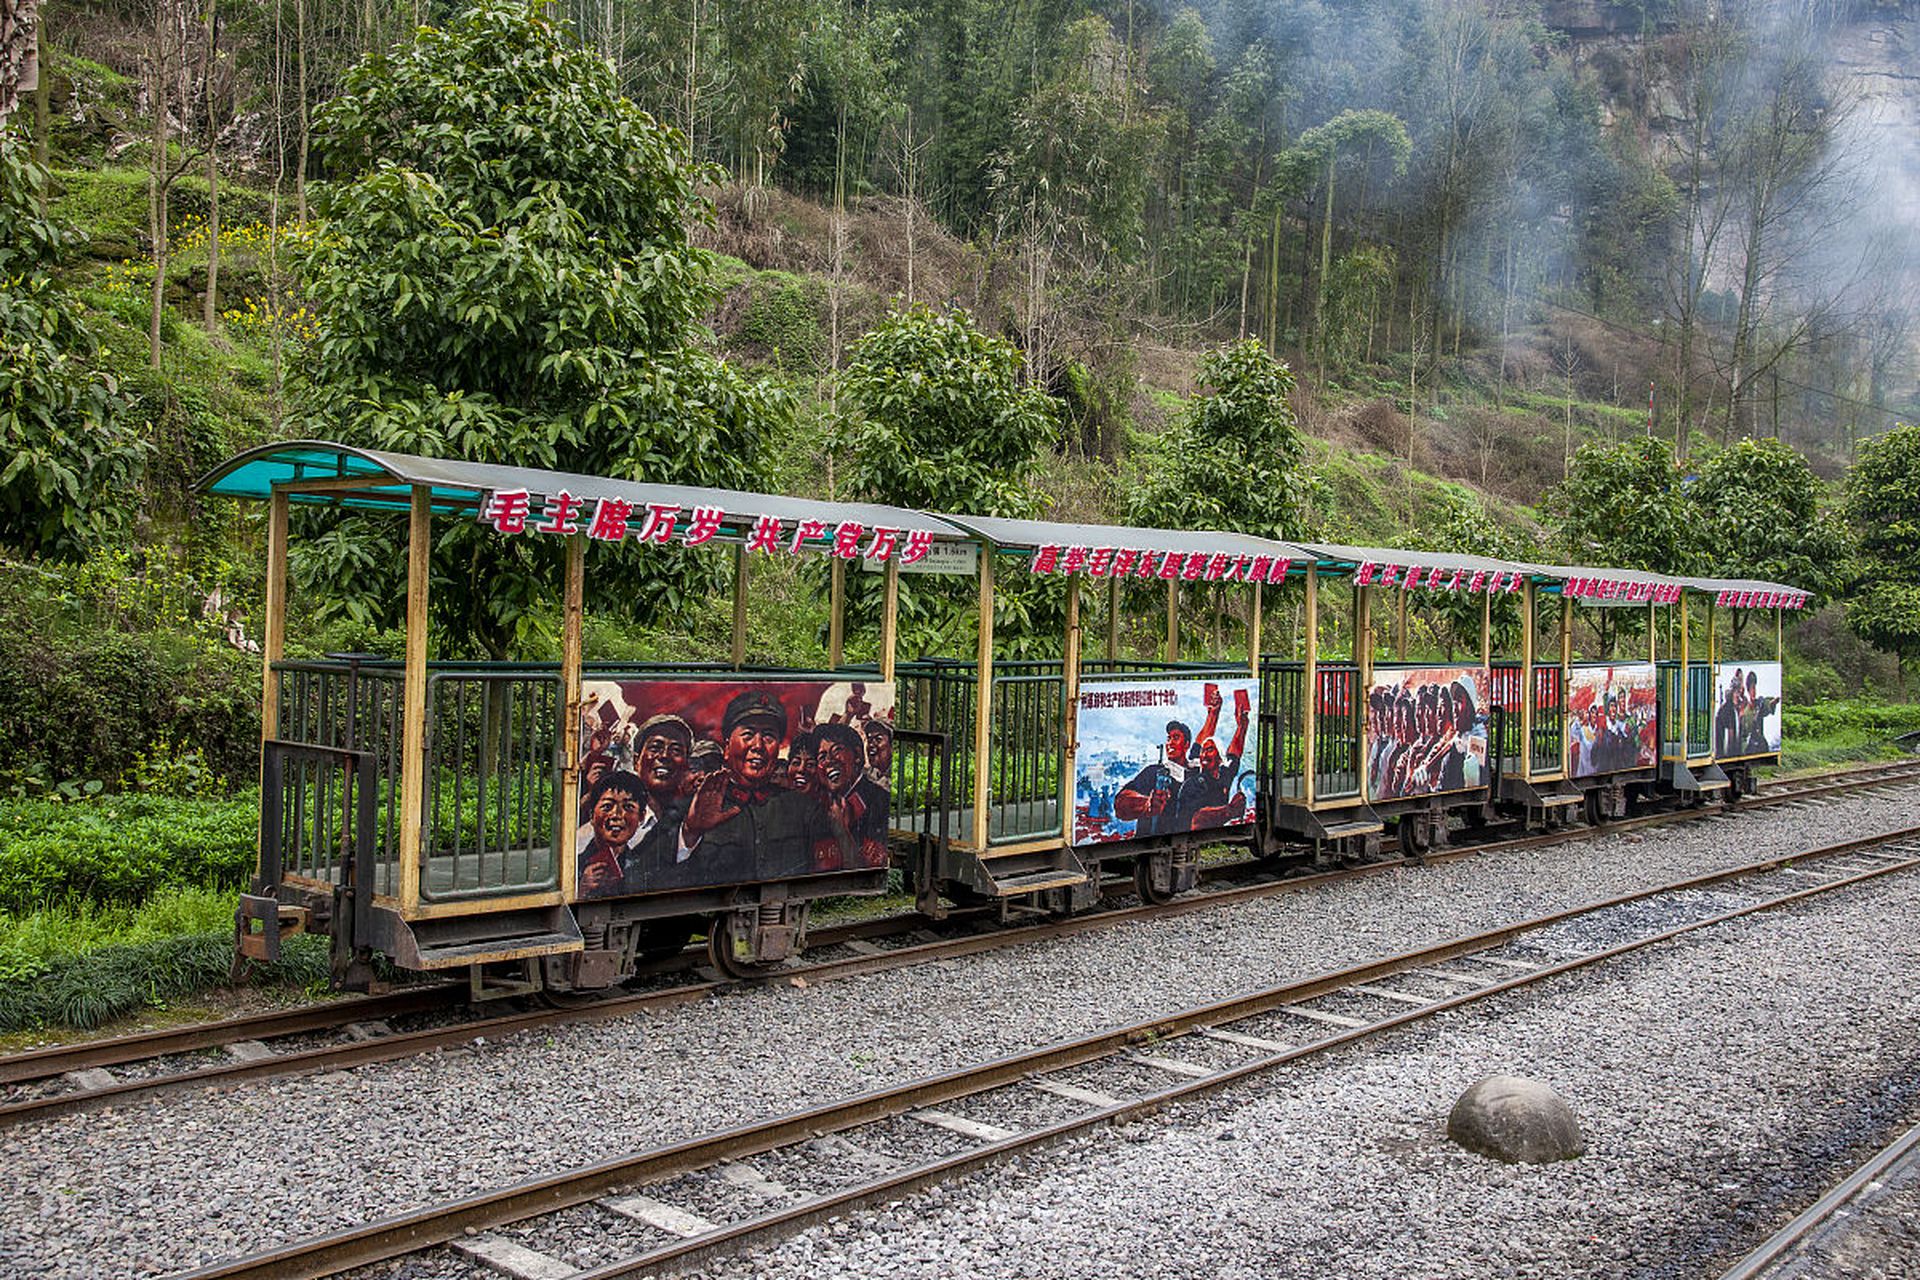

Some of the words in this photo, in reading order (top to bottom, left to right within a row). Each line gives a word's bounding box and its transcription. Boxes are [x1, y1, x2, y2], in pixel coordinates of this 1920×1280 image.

[489, 487, 725, 547] 毛主席万岁
[745, 514, 935, 565] 共产党万岁
[1031, 544, 1293, 584] 高举毛泽东思想伟大旗帜
[1354, 560, 1523, 594] 知识青年大有作为
